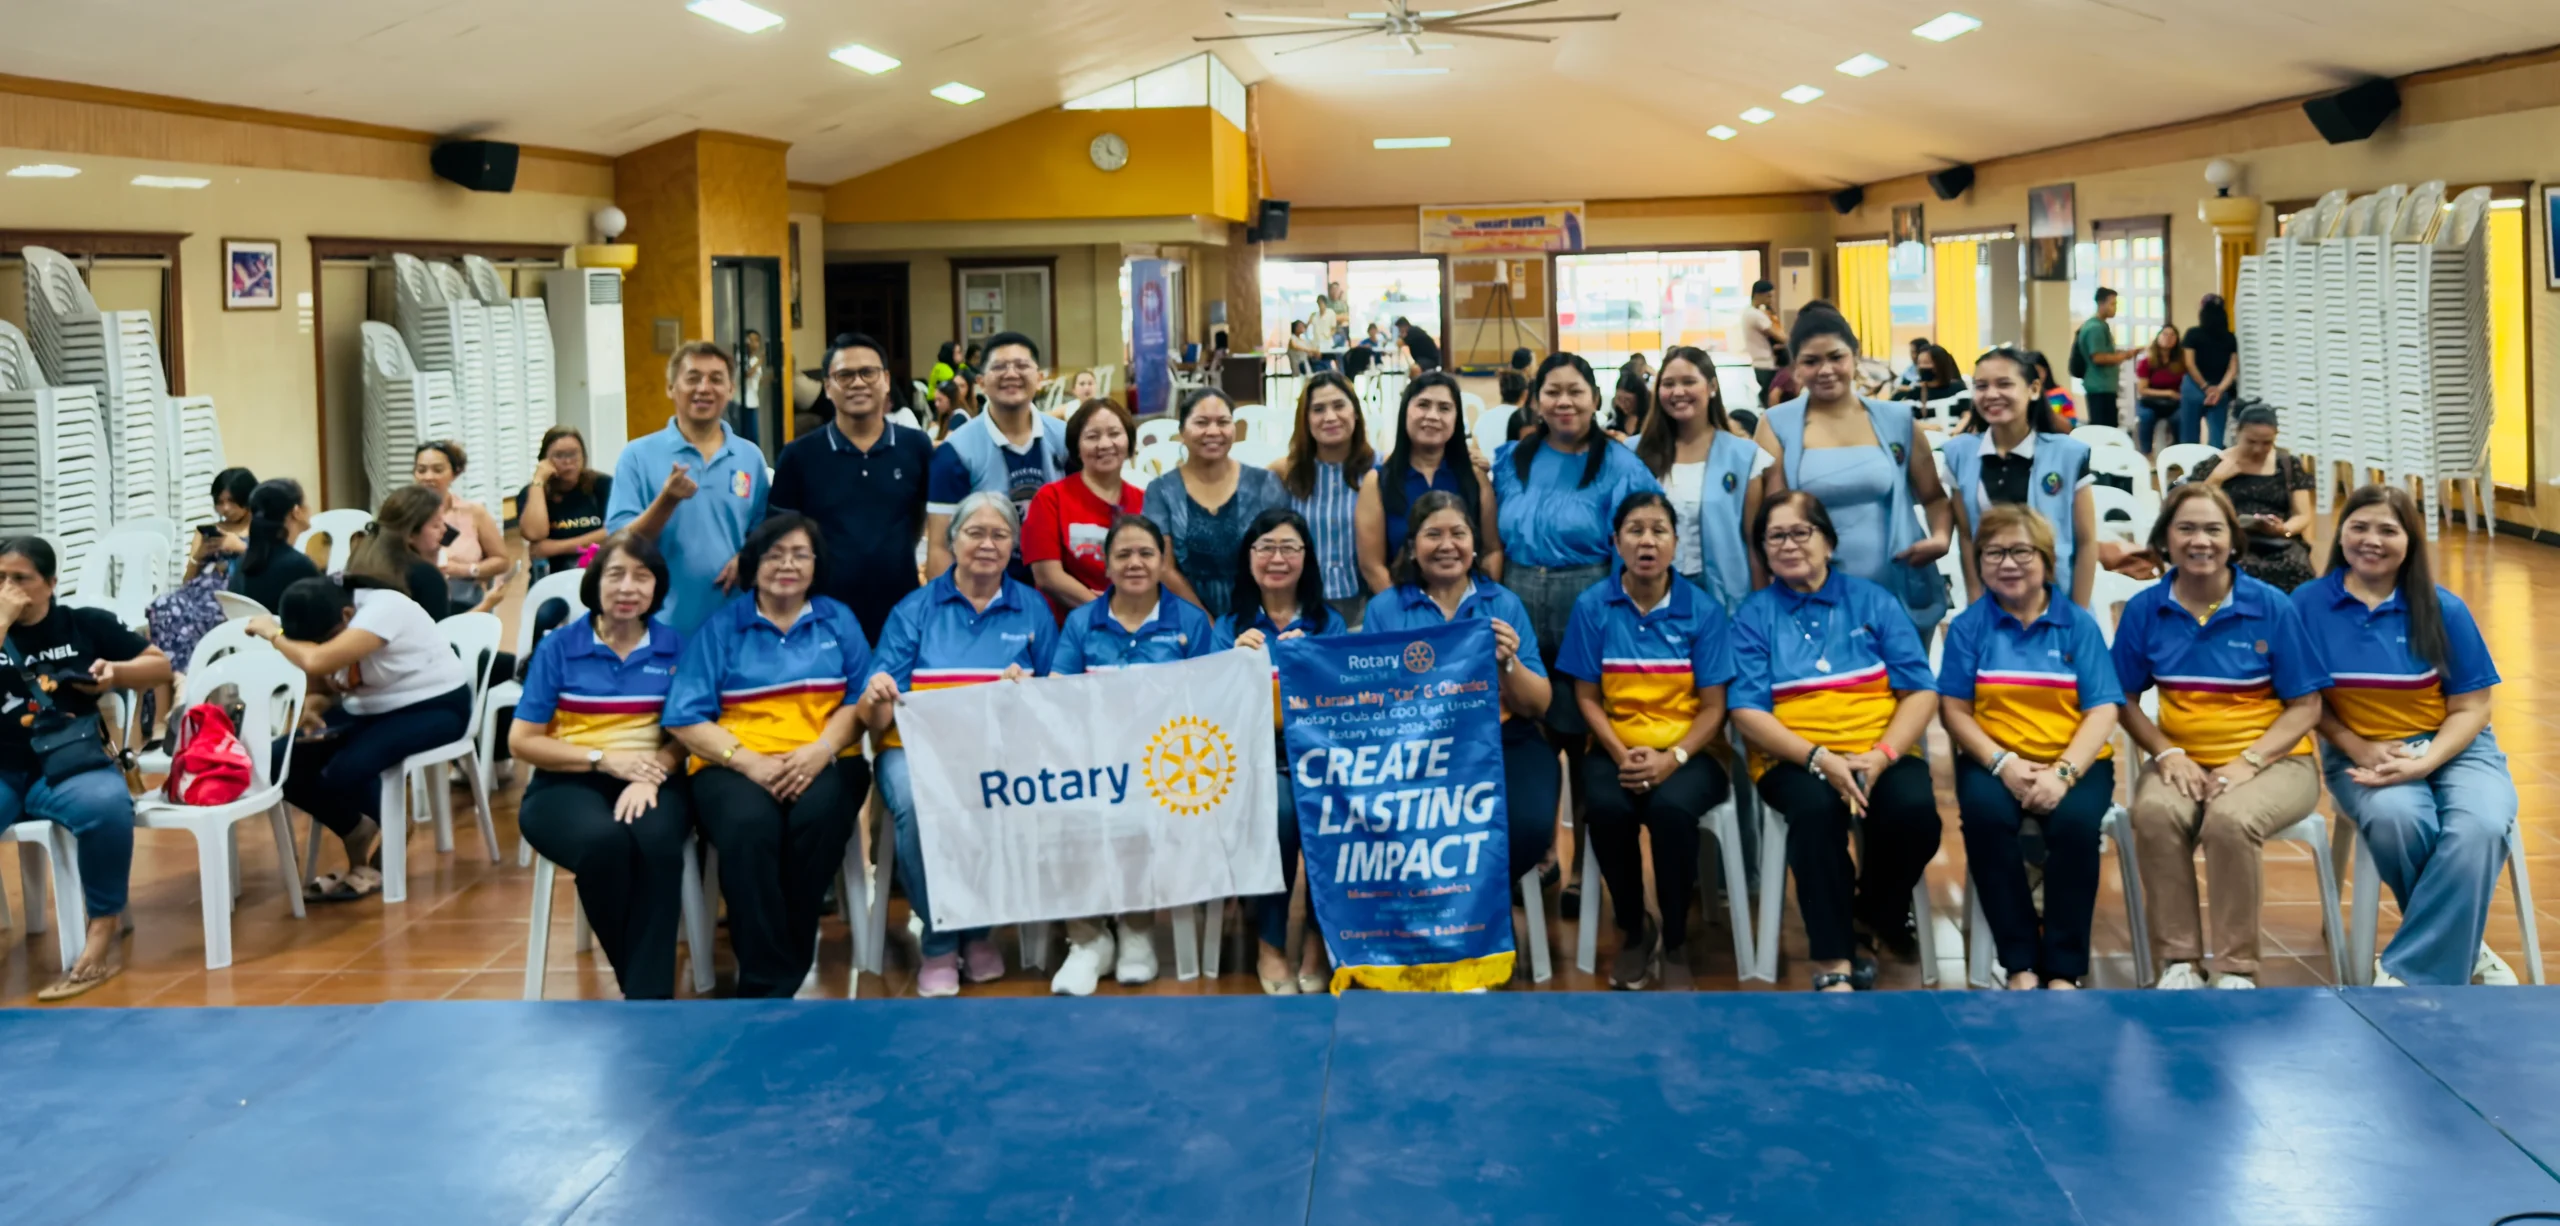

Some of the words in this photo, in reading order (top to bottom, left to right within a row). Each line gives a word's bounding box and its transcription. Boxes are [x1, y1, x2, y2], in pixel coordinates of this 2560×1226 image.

[1348, 654, 1400, 670] Rotary
[1341, 710, 1370, 723] Club
[1373, 710, 1386, 721] of
[1389, 705, 1417, 719] CDO
[1358, 691, 1384, 707] May
[1328, 728, 1368, 741] Rotary
[1370, 725, 1396, 737] Year
[1297, 736, 1455, 788] CREATE
[980, 763, 1129, 809] Rotary
[1318, 781, 1496, 835] LASTING
[1334, 831, 1490, 884] IMPACT
